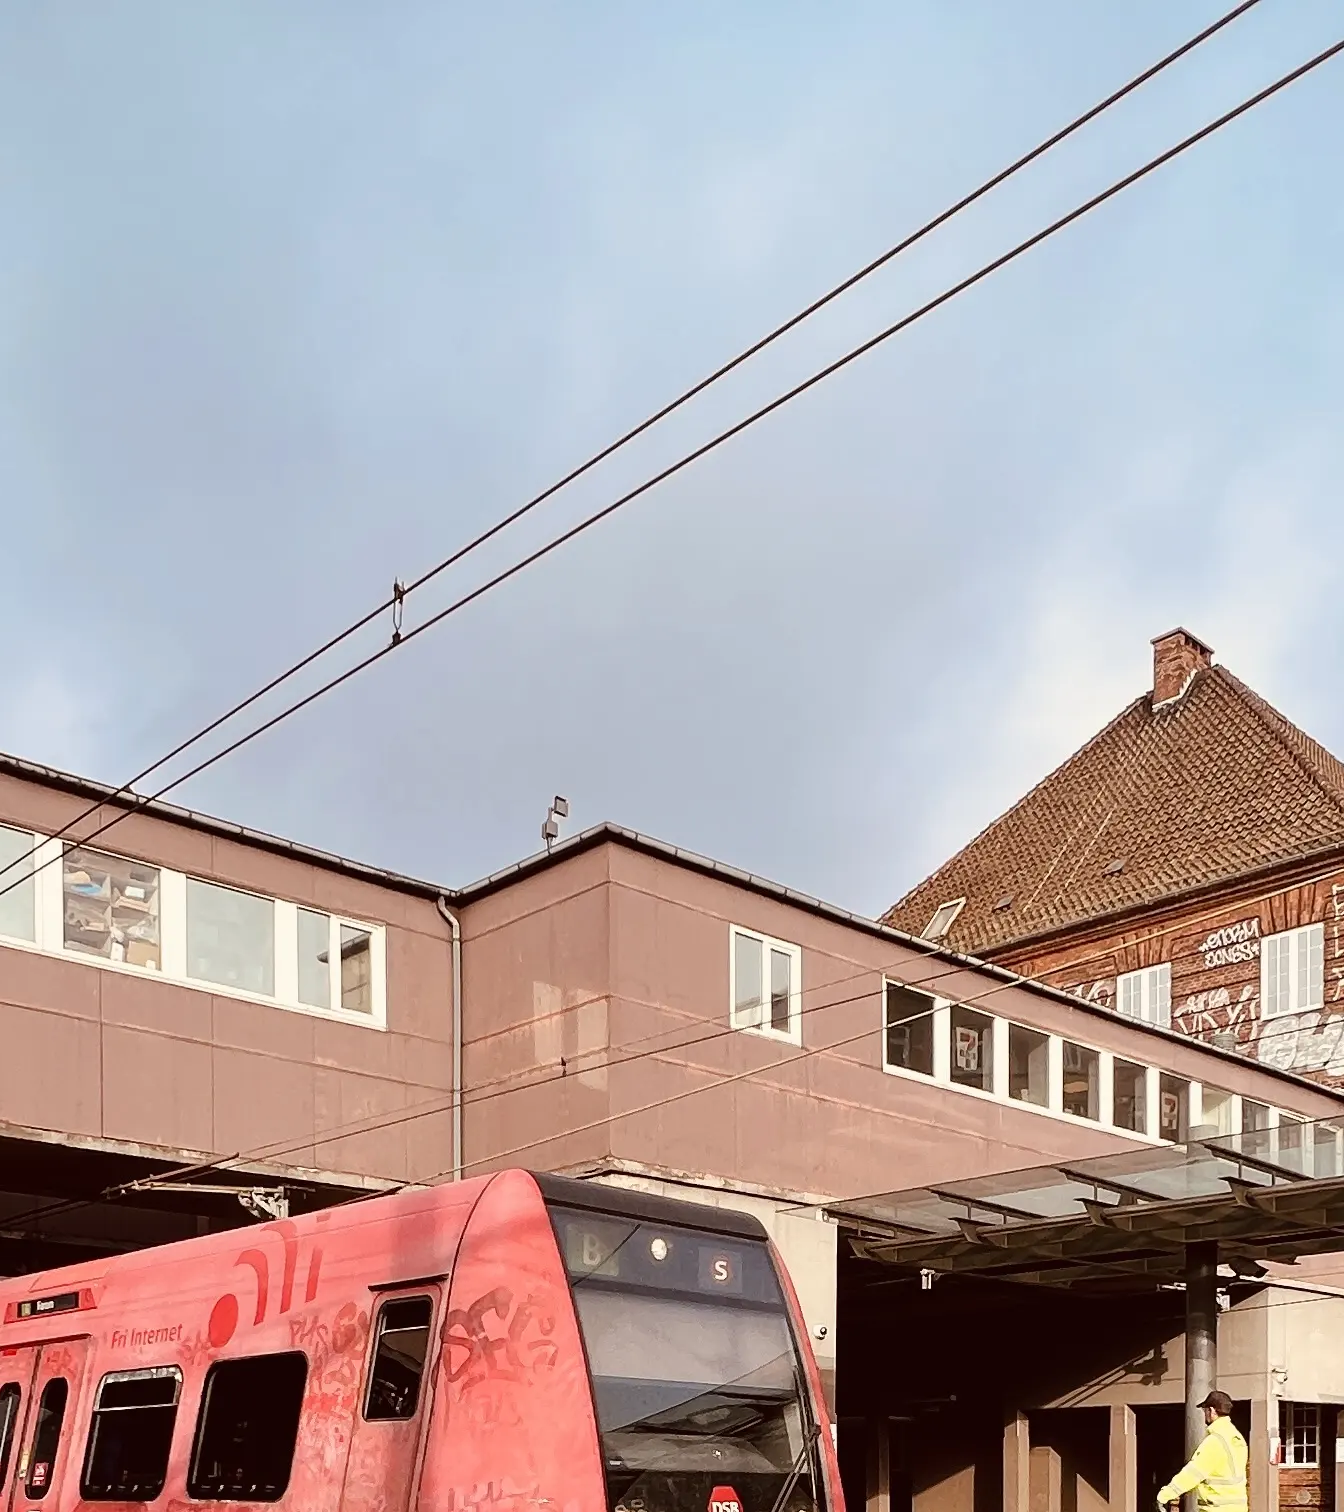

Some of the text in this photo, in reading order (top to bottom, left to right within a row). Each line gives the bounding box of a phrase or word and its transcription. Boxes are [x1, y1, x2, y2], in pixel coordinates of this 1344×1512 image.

[582, 1233, 602, 1266] B
[714, 1260, 728, 1281] S
[111, 1323, 183, 1349] Fri Internet
